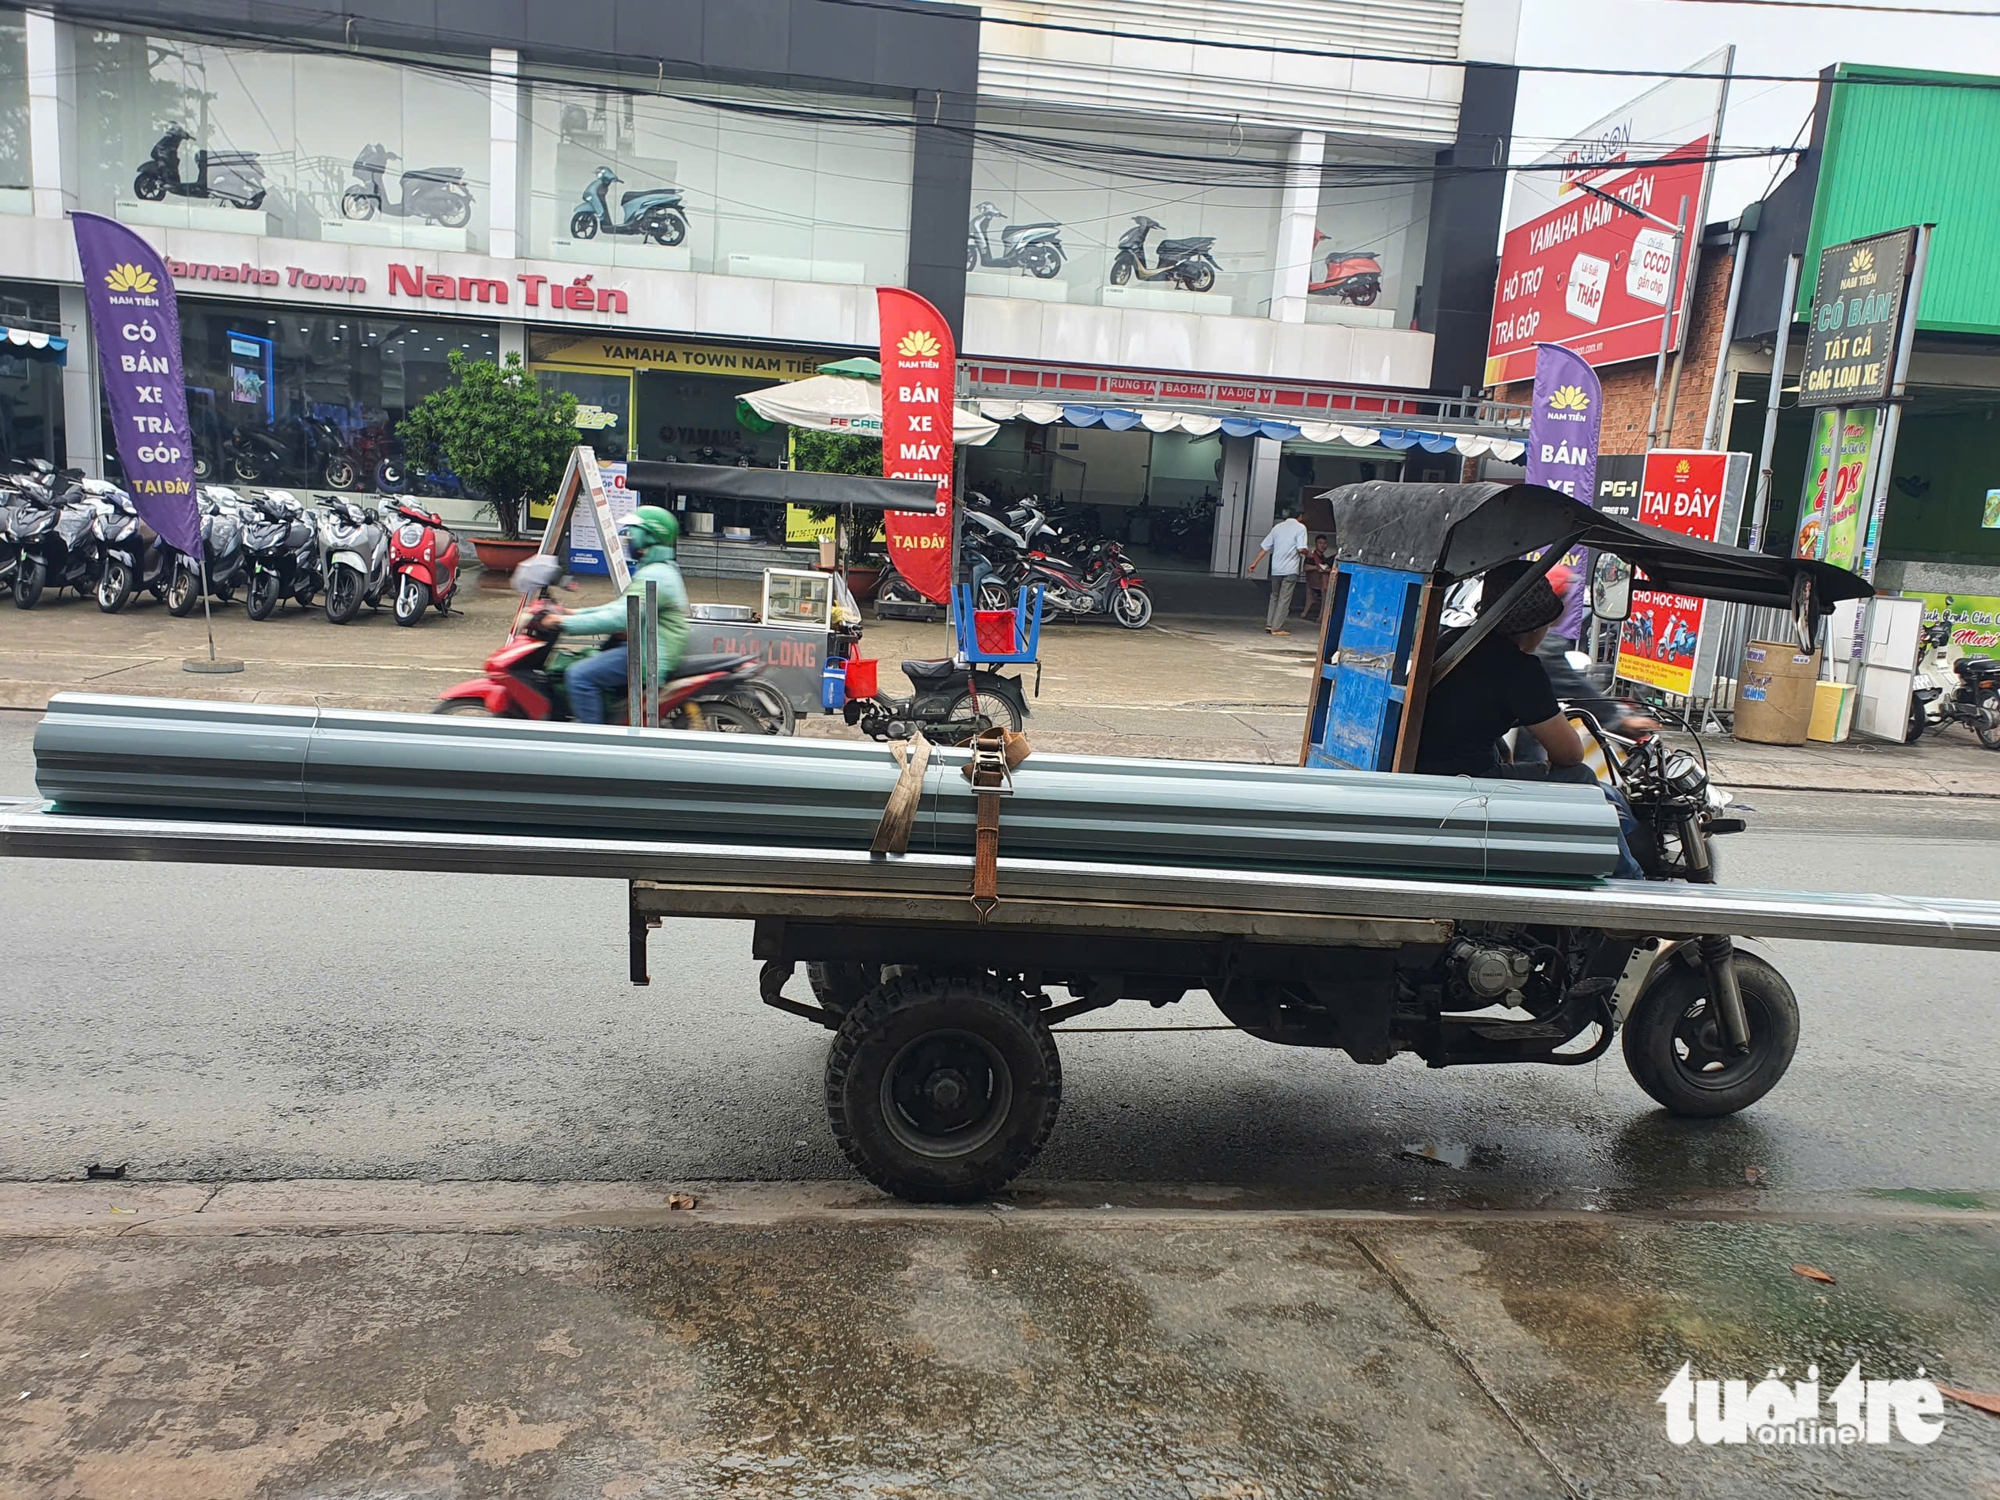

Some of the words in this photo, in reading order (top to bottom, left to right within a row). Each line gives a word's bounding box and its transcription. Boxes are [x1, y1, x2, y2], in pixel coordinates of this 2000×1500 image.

[1529, 210, 1579, 256] YAMAHA
[1581, 193, 1615, 234] NAM
[1617, 172, 1655, 219] TIẾN
[164, 256, 279, 286] amaha
[286, 266, 367, 292] Town
[1643, 250, 1671, 275] CCCD
[387, 263, 509, 304] Nam
[517, 274, 628, 314] Tiến
[1520, 265, 1545, 298] TRỢ
[1840, 276, 1858, 290] NAM
[109, 296, 134, 305] NAM
[1577, 280, 1601, 308] THẤP
[1817, 295, 1845, 332] CÓ
[122, 319, 157, 343] CÓ
[1495, 313, 1515, 345] TRẢ
[1516, 307, 1540, 339] GÓP
[1824, 331, 1850, 361] TẤT
[1852, 328, 1873, 357] CẢ
[121, 349, 169, 374] BÁN
[602, 345, 677, 363] YAMAHA
[682, 351, 737, 368] TOWN
[741, 356, 781, 372] NAM
[898, 360, 919, 369] NAM
[1808, 363, 1832, 391] CÁC
[1834, 364, 1858, 392] LOẠI
[1862, 361, 1881, 387] XE
[135, 386, 163, 404] XE
[898, 381, 939, 403] BÁN
[831, 417, 848, 427] FE
[908, 415, 932, 431] XE
[1547, 412, 1567, 420] NAM
[137, 440, 181, 464] GÓP
[900, 439, 942, 461] MÁY
[1541, 439, 1588, 466] BÁN
[132, 479, 163, 497] TẠI
[164, 477, 190, 495] ĐÂY
[1599, 481, 1639, 497] PG-1
[1619, 507, 1630, 515] TO
[1643, 490, 1671, 520] TẠI
[1674, 487, 1717, 518] ĐÂY
[893, 535, 918, 552] TẠI
[919, 532, 946, 549] ĐÂY
[1632, 590, 1651, 603] CHO
[1652, 592, 1673, 608] HỌC
[1674, 596, 1698, 612] SINH
[768, 634, 817, 668] LÒNG
